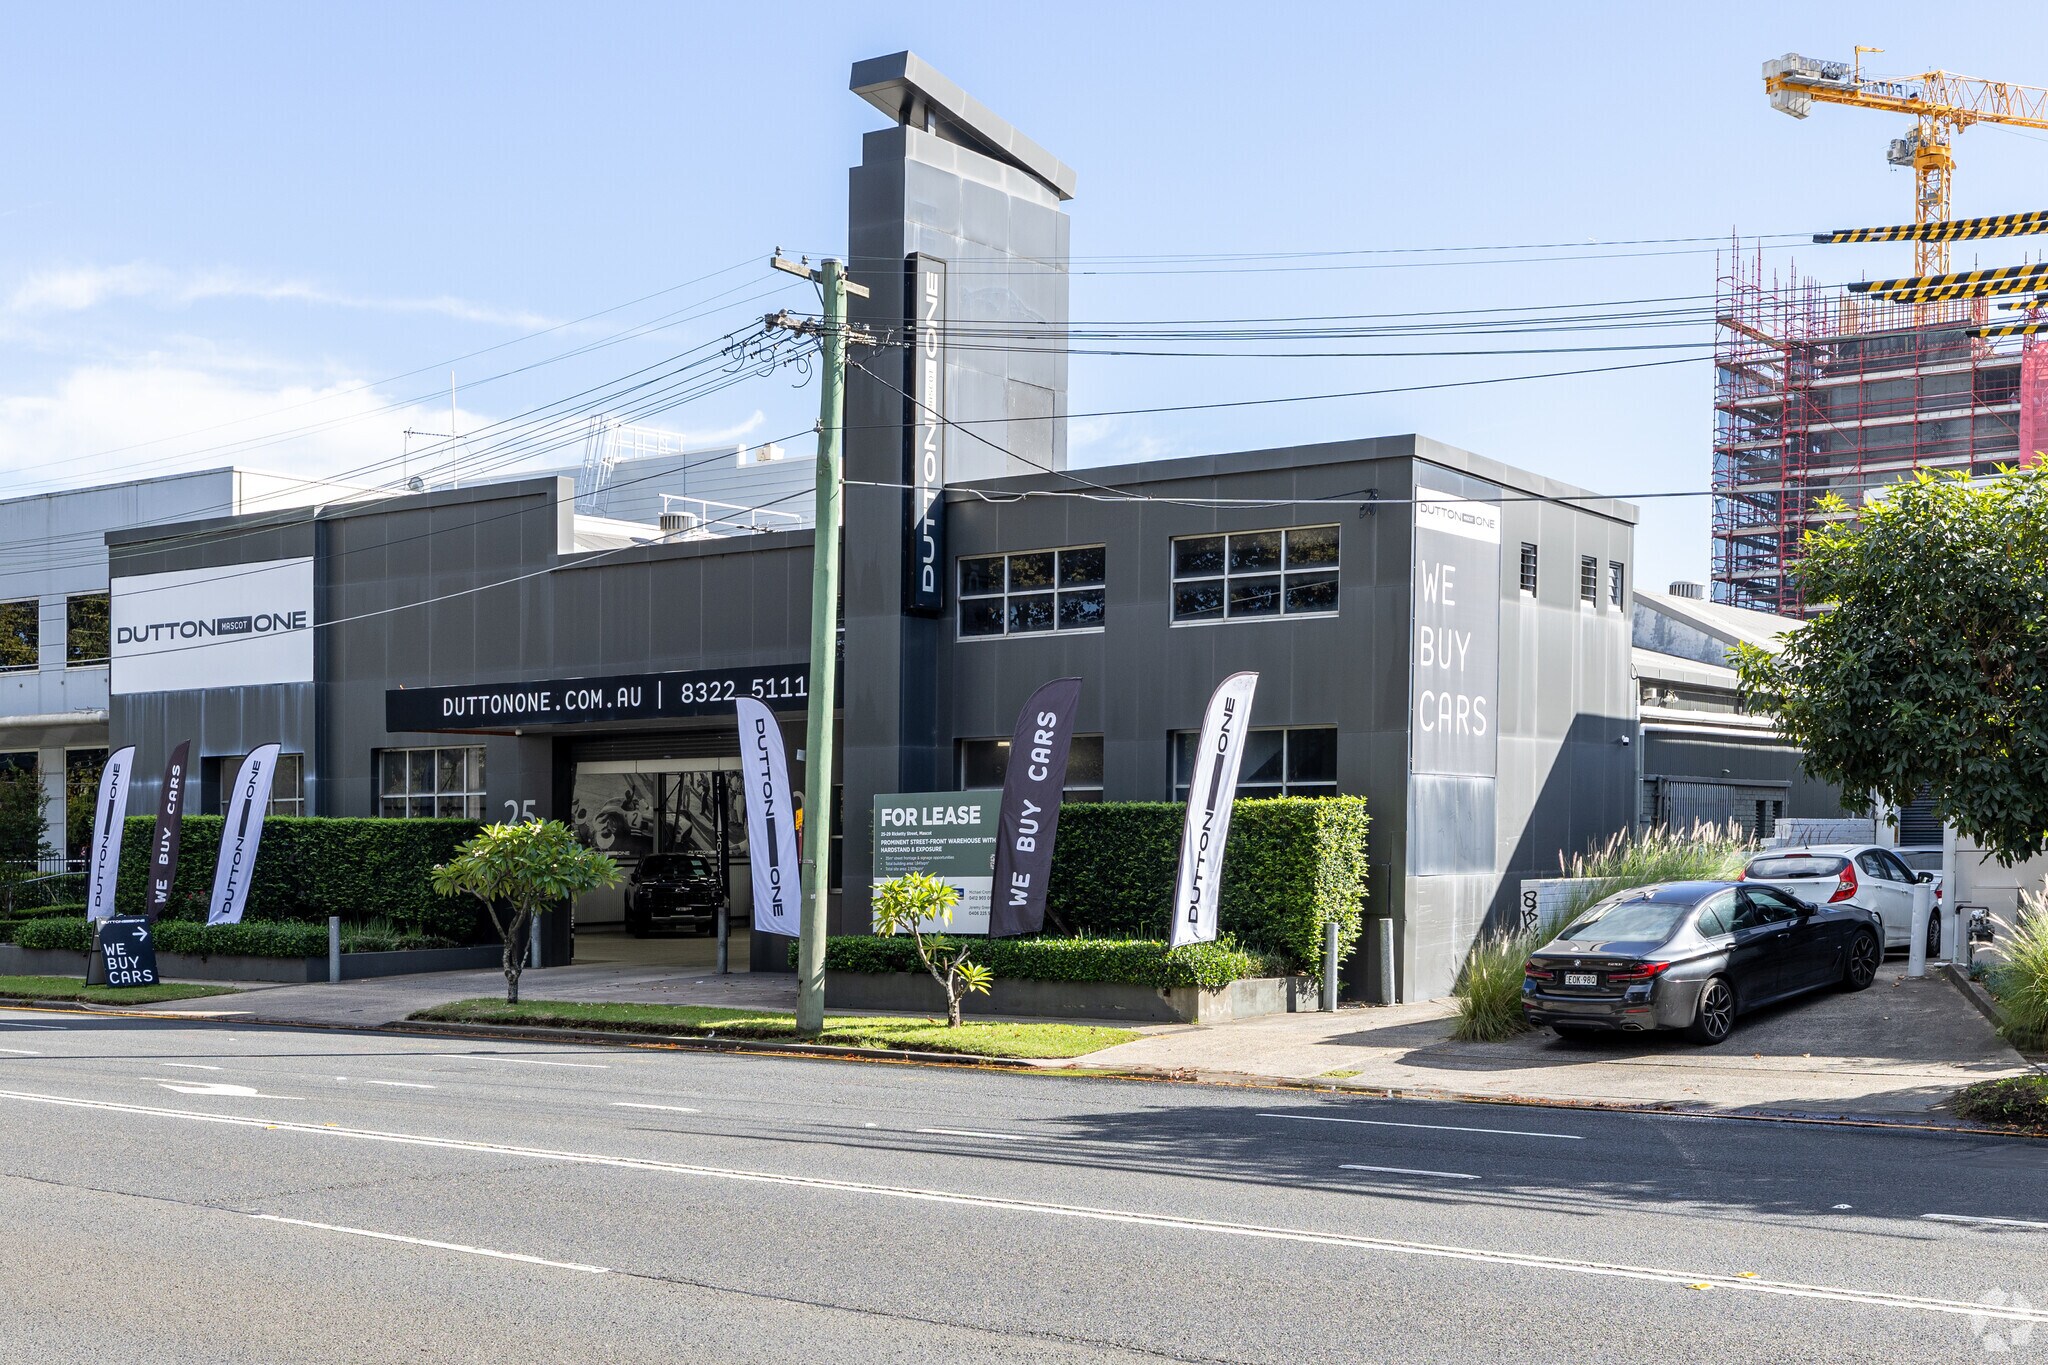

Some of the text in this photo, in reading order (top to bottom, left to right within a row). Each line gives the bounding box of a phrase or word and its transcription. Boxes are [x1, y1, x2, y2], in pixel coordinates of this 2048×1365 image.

[925, 271, 938, 359] ONE
[922, 418, 937, 593] DUTTON
[1420, 503, 1495, 529] DUTTON ONE
[1421, 559, 1456, 606] WE
[117, 610, 307, 644] DUTTON MASCOT ONE
[1420, 625, 1471, 672] BUY
[442, 675, 809, 717] DUTTONONE.COM.AU 8322 5111
[1419, 689, 1487, 737] CARS
[503, 799, 536, 827] 25
[755, 718, 784, 917] DUTTON ONE
[881, 805, 982, 827] FOR LEASE
[1008, 711, 1057, 906] WE BUY CARS
[1187, 696, 1236, 924] DUTTON ONE
[94, 762, 121, 907] DUTTON ONE
[154, 764, 181, 904] WE BUY CARS
[221, 760, 262, 914] DUTTON ONE
[103, 942, 127, 956] WE
[107, 955, 139, 970] BUY
[109, 969, 153, 984] CARS
